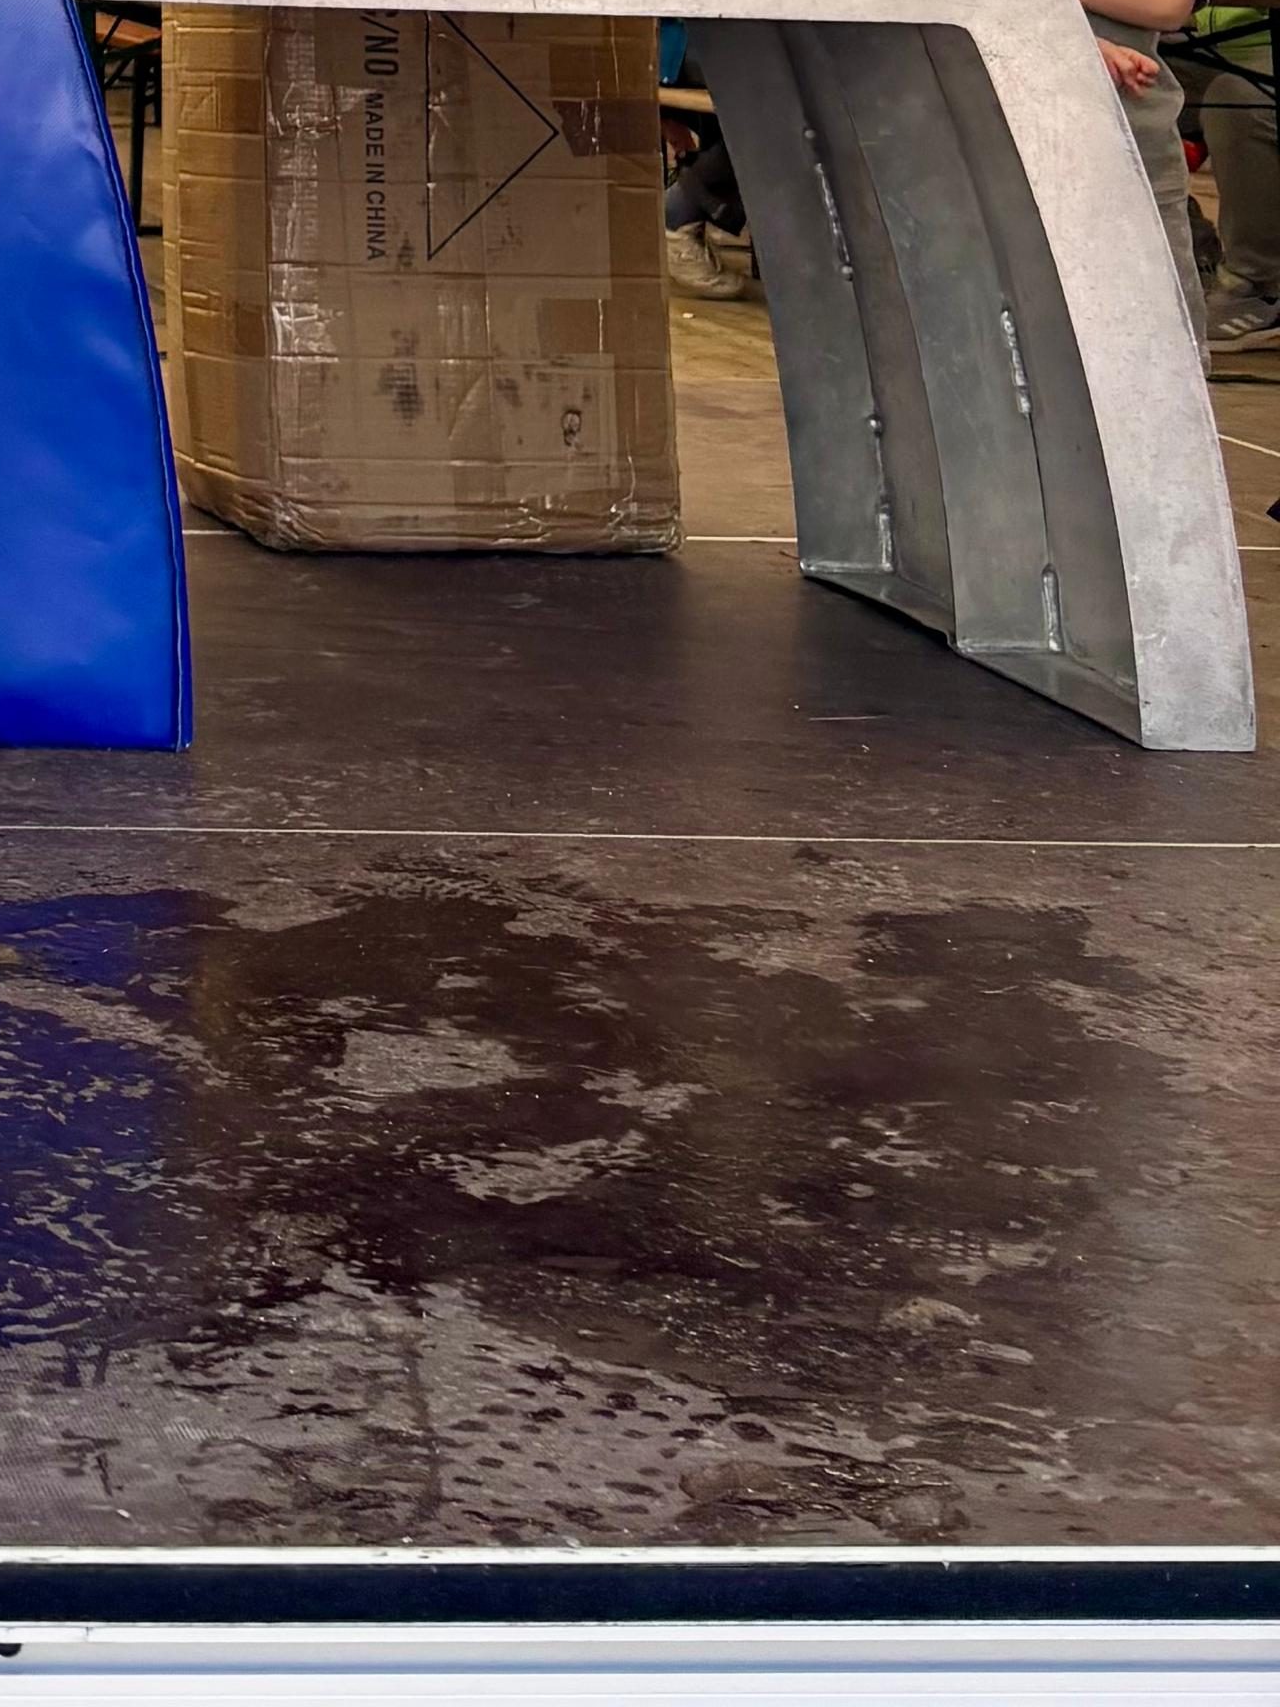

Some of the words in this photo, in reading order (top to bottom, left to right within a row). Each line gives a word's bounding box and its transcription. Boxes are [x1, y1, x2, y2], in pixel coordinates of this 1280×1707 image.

[365, 92, 385, 157] MADE
[365, 163, 385, 184] IN
[366, 190, 386, 261] CHINA
